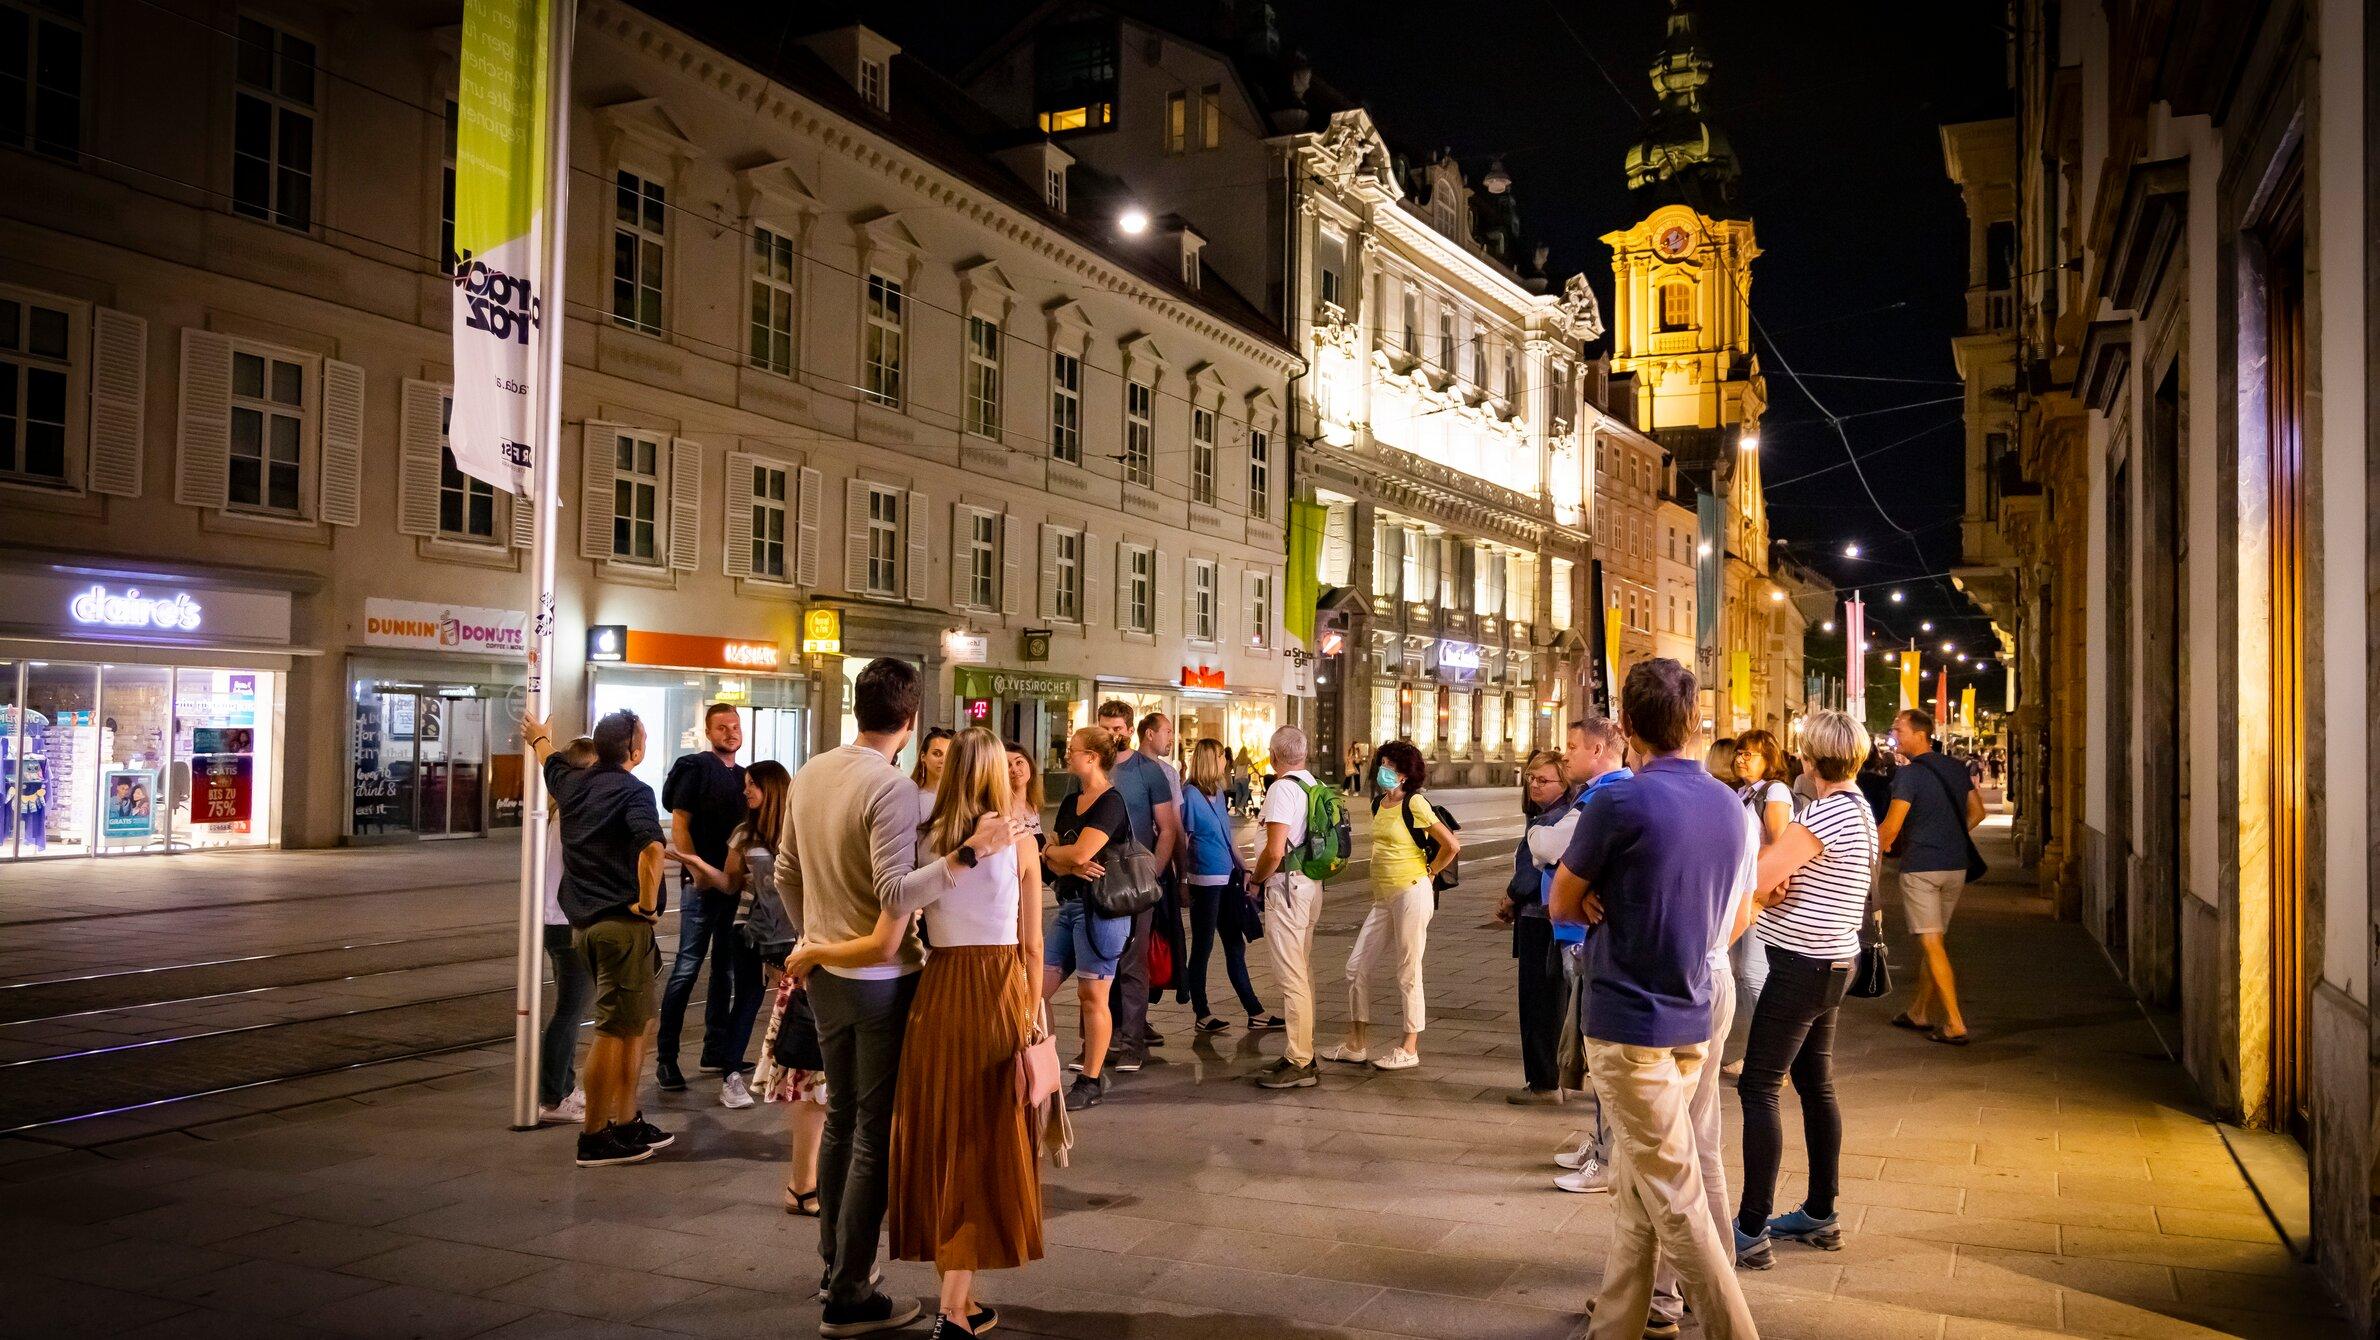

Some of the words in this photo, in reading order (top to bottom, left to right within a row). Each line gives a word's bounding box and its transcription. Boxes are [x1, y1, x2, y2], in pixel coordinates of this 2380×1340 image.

[73, 586, 201, 629] claire's
[368, 617, 440, 638] DUNKIN'
[462, 625, 522, 644] DONUTS
[1034, 680, 1071, 693] ROCHER
[208, 788, 223, 801] BIS
[225, 788, 237, 800] ZU
[208, 800, 237, 818] 75%
